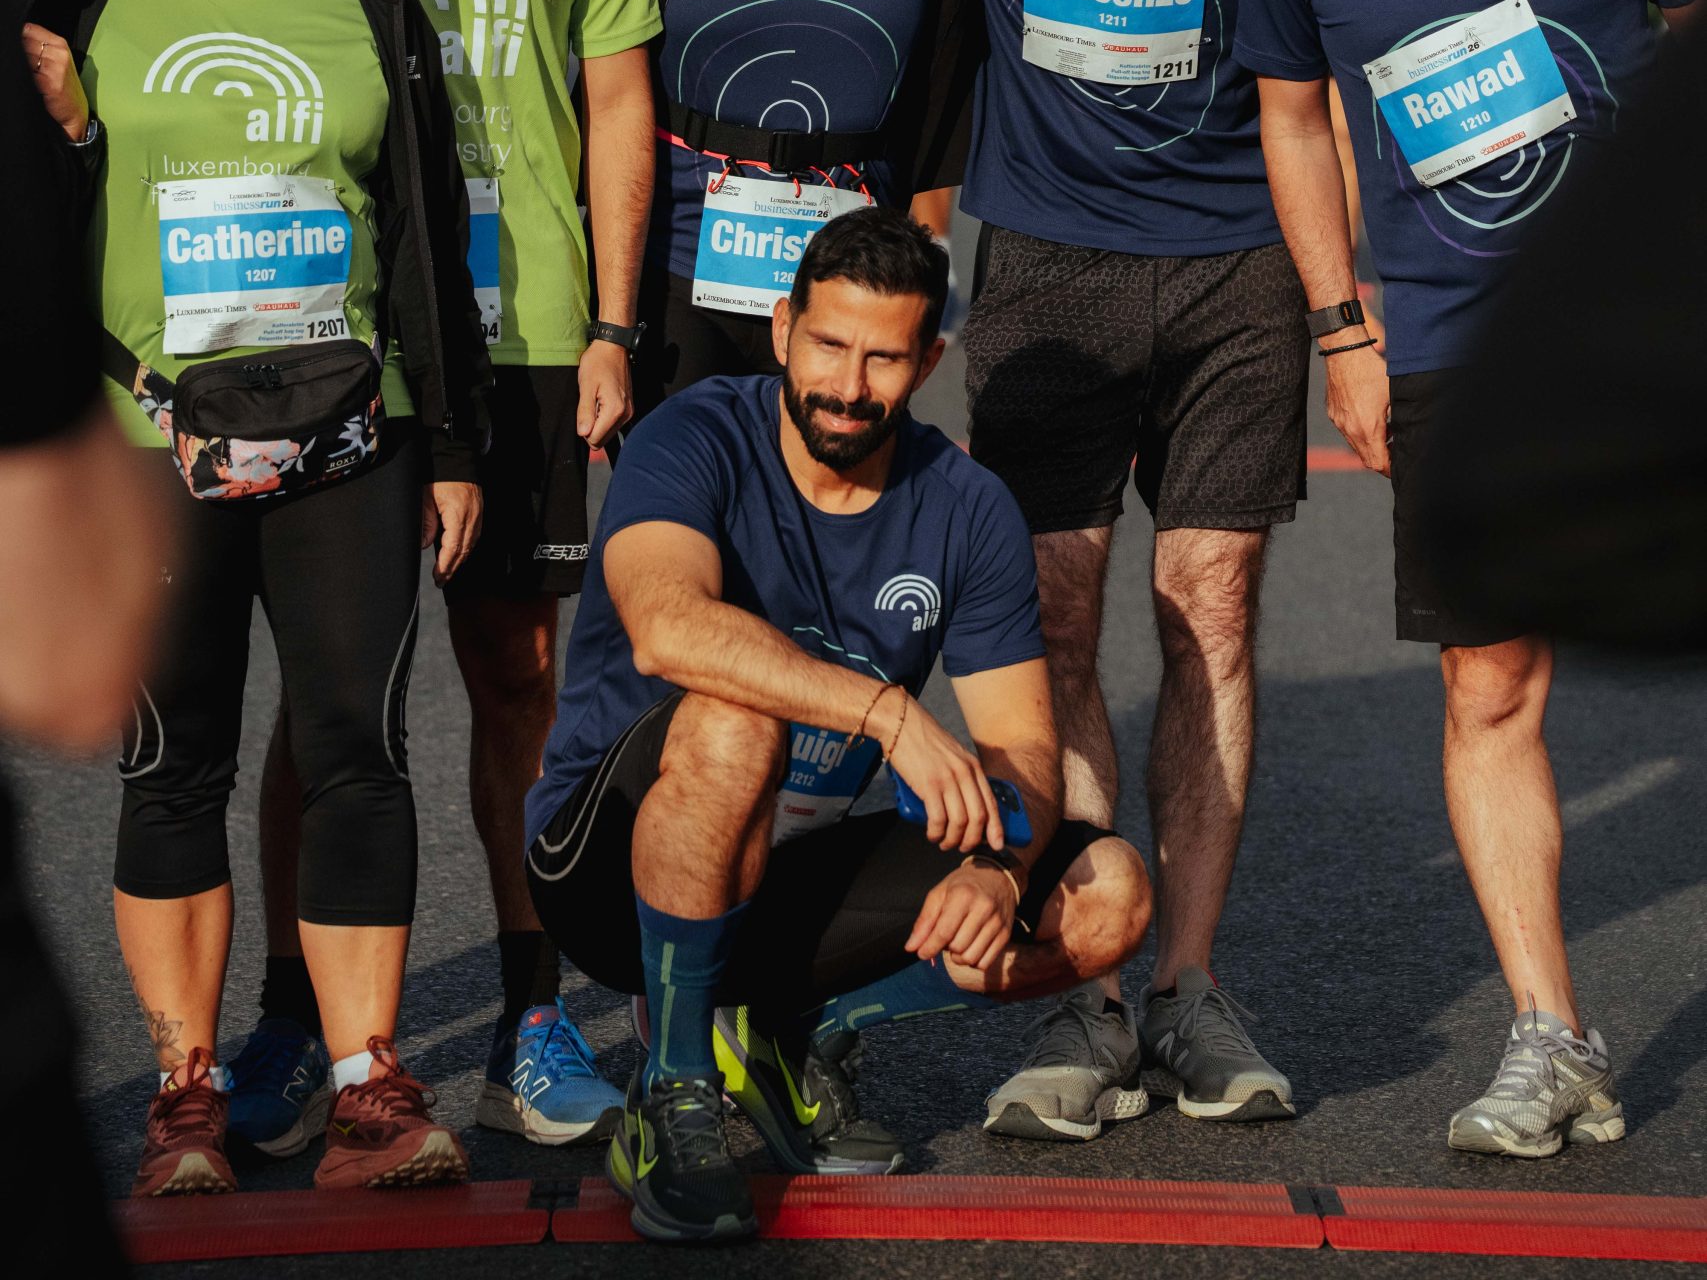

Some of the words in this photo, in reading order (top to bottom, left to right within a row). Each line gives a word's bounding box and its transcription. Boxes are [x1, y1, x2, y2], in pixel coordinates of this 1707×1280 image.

[1098, 12, 1128, 27] 1211
[440, 17, 525, 77] alfi
[1153, 59, 1194, 79] 1211
[1402, 49, 1526, 129] Rawad
[246, 99, 324, 145] alfi
[1460, 110, 1491, 132] 1210
[167, 221, 345, 264] Catherine
[245, 268, 277, 282] 1207
[772, 271, 795, 284] 120
[307, 318, 345, 339] 1207
[912, 608, 940, 631] alfi
[791, 730, 849, 773] uigi
[789, 770, 815, 787] 1212
